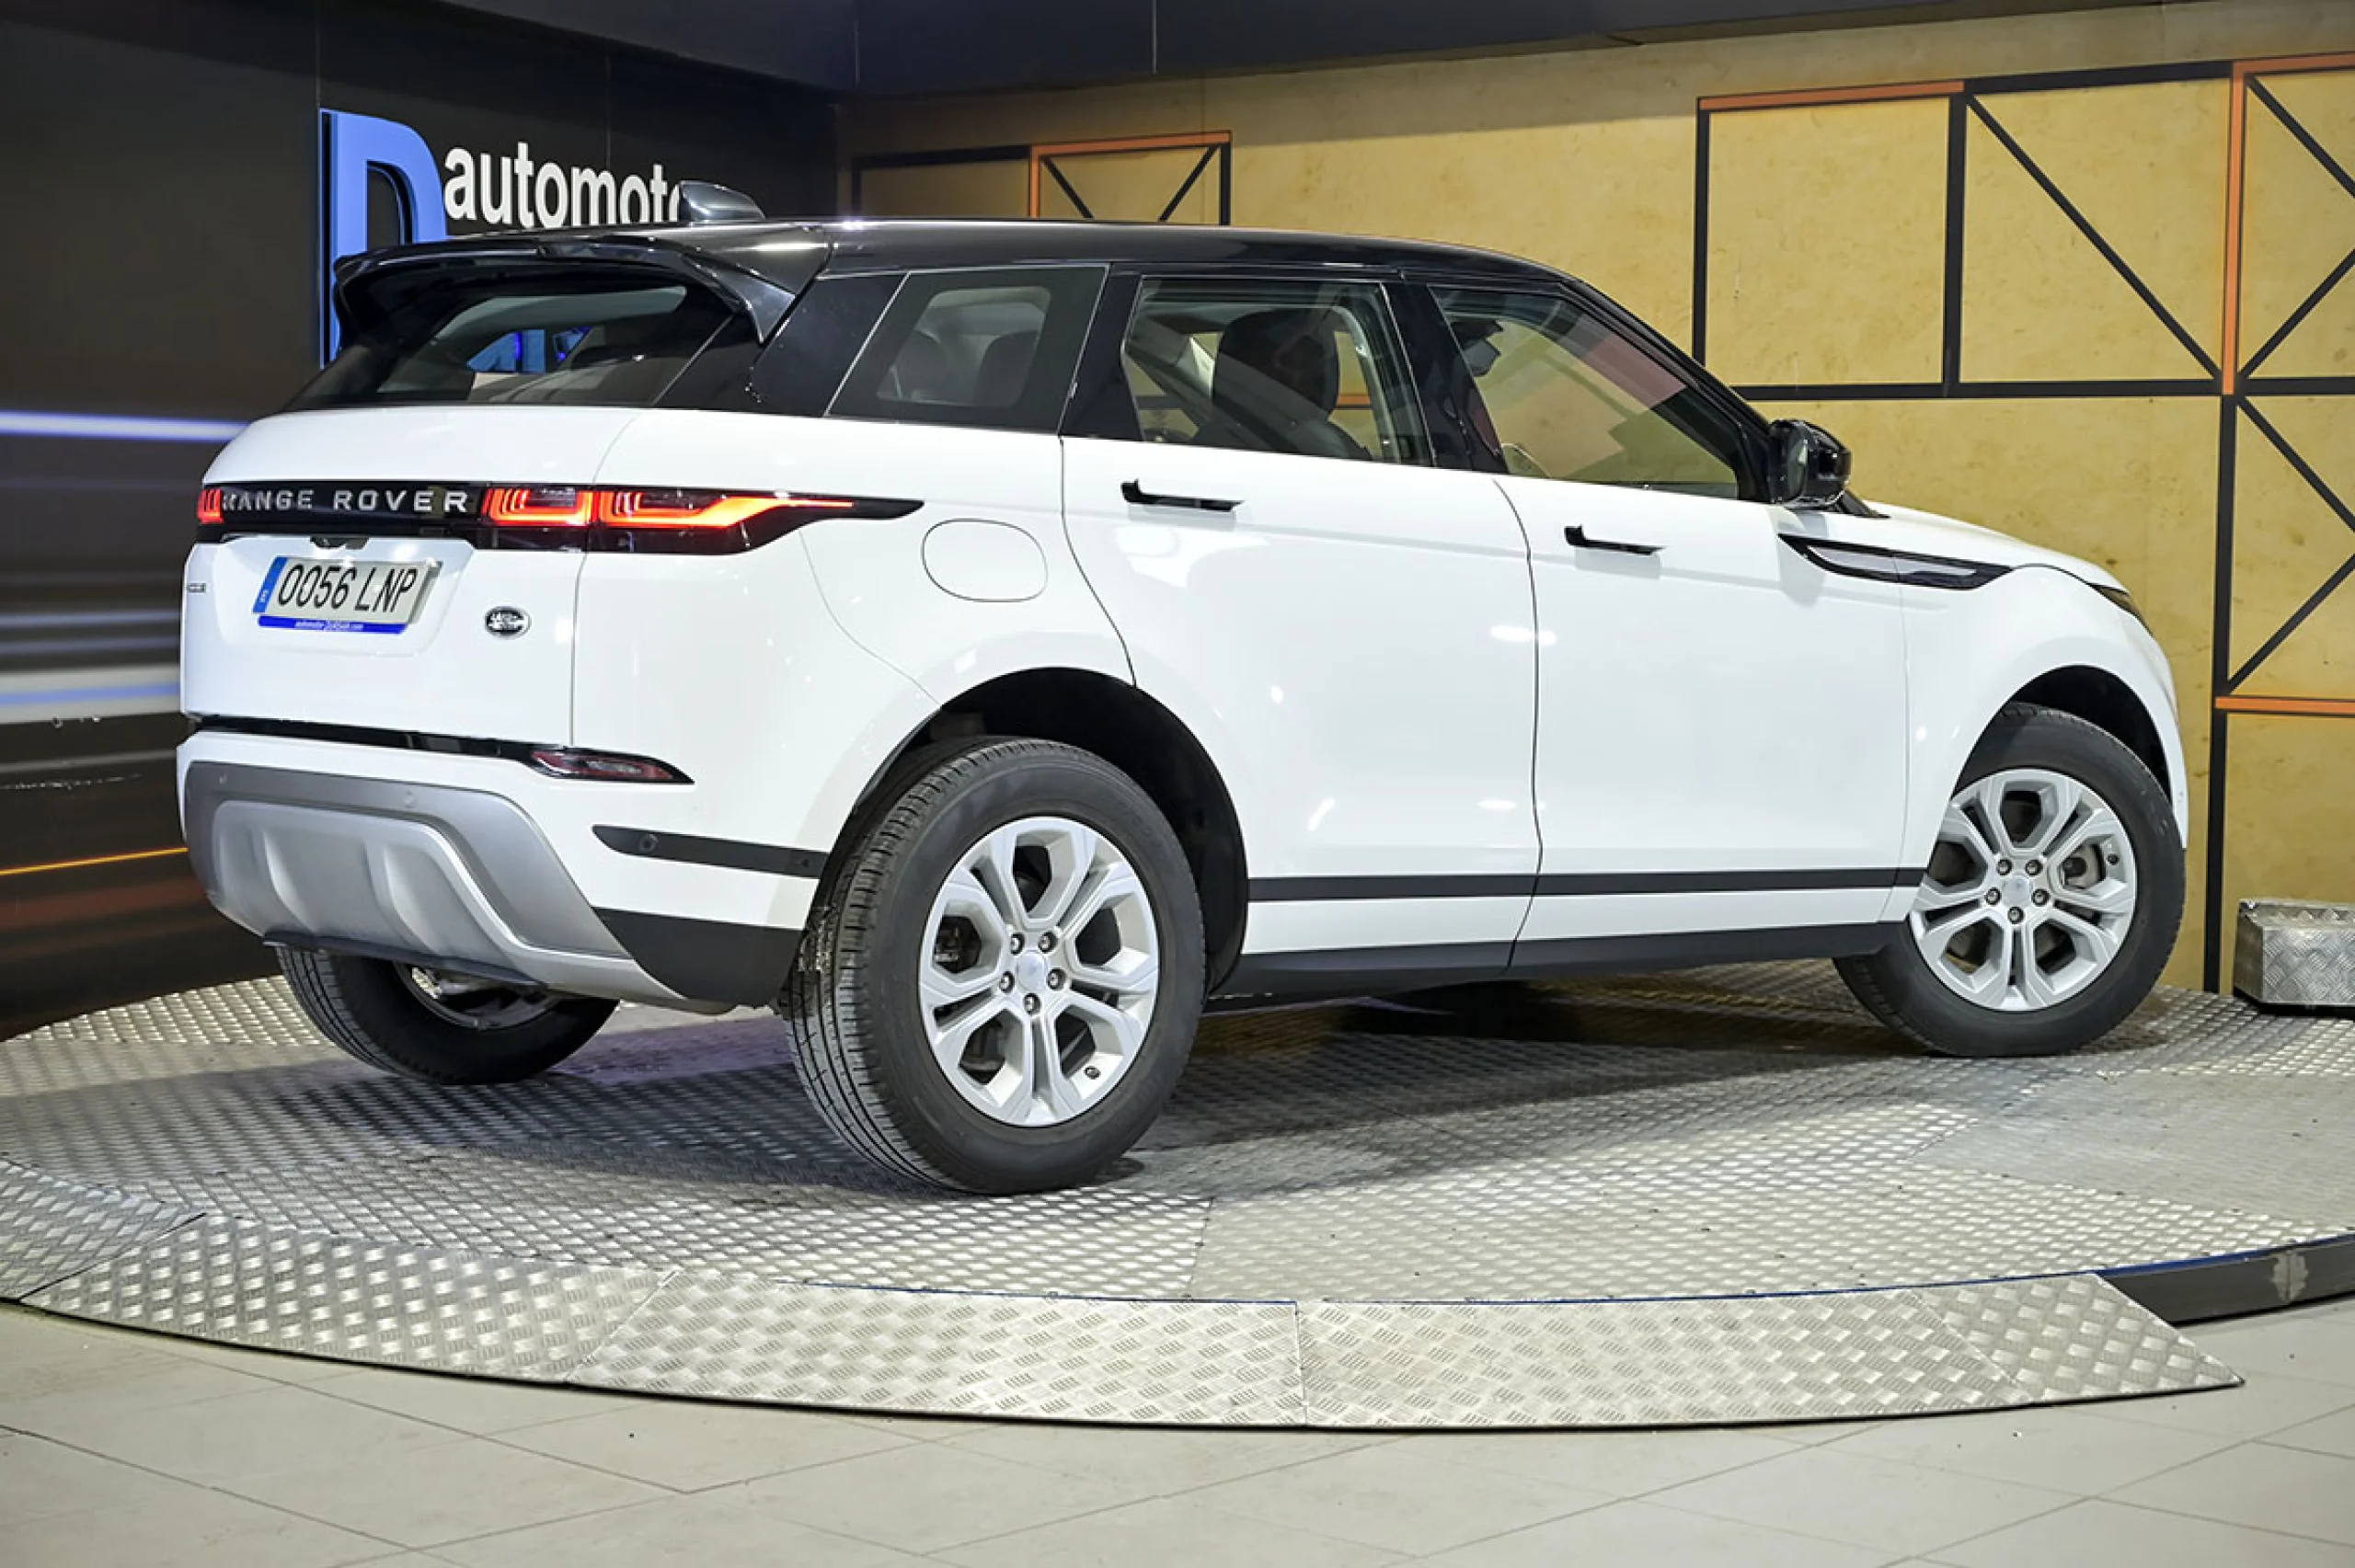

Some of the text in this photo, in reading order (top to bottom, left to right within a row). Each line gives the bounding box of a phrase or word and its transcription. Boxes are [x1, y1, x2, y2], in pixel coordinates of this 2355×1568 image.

[223, 489, 468, 512] RANGE ROVER
[278, 564, 418, 613] 0056 LNP
